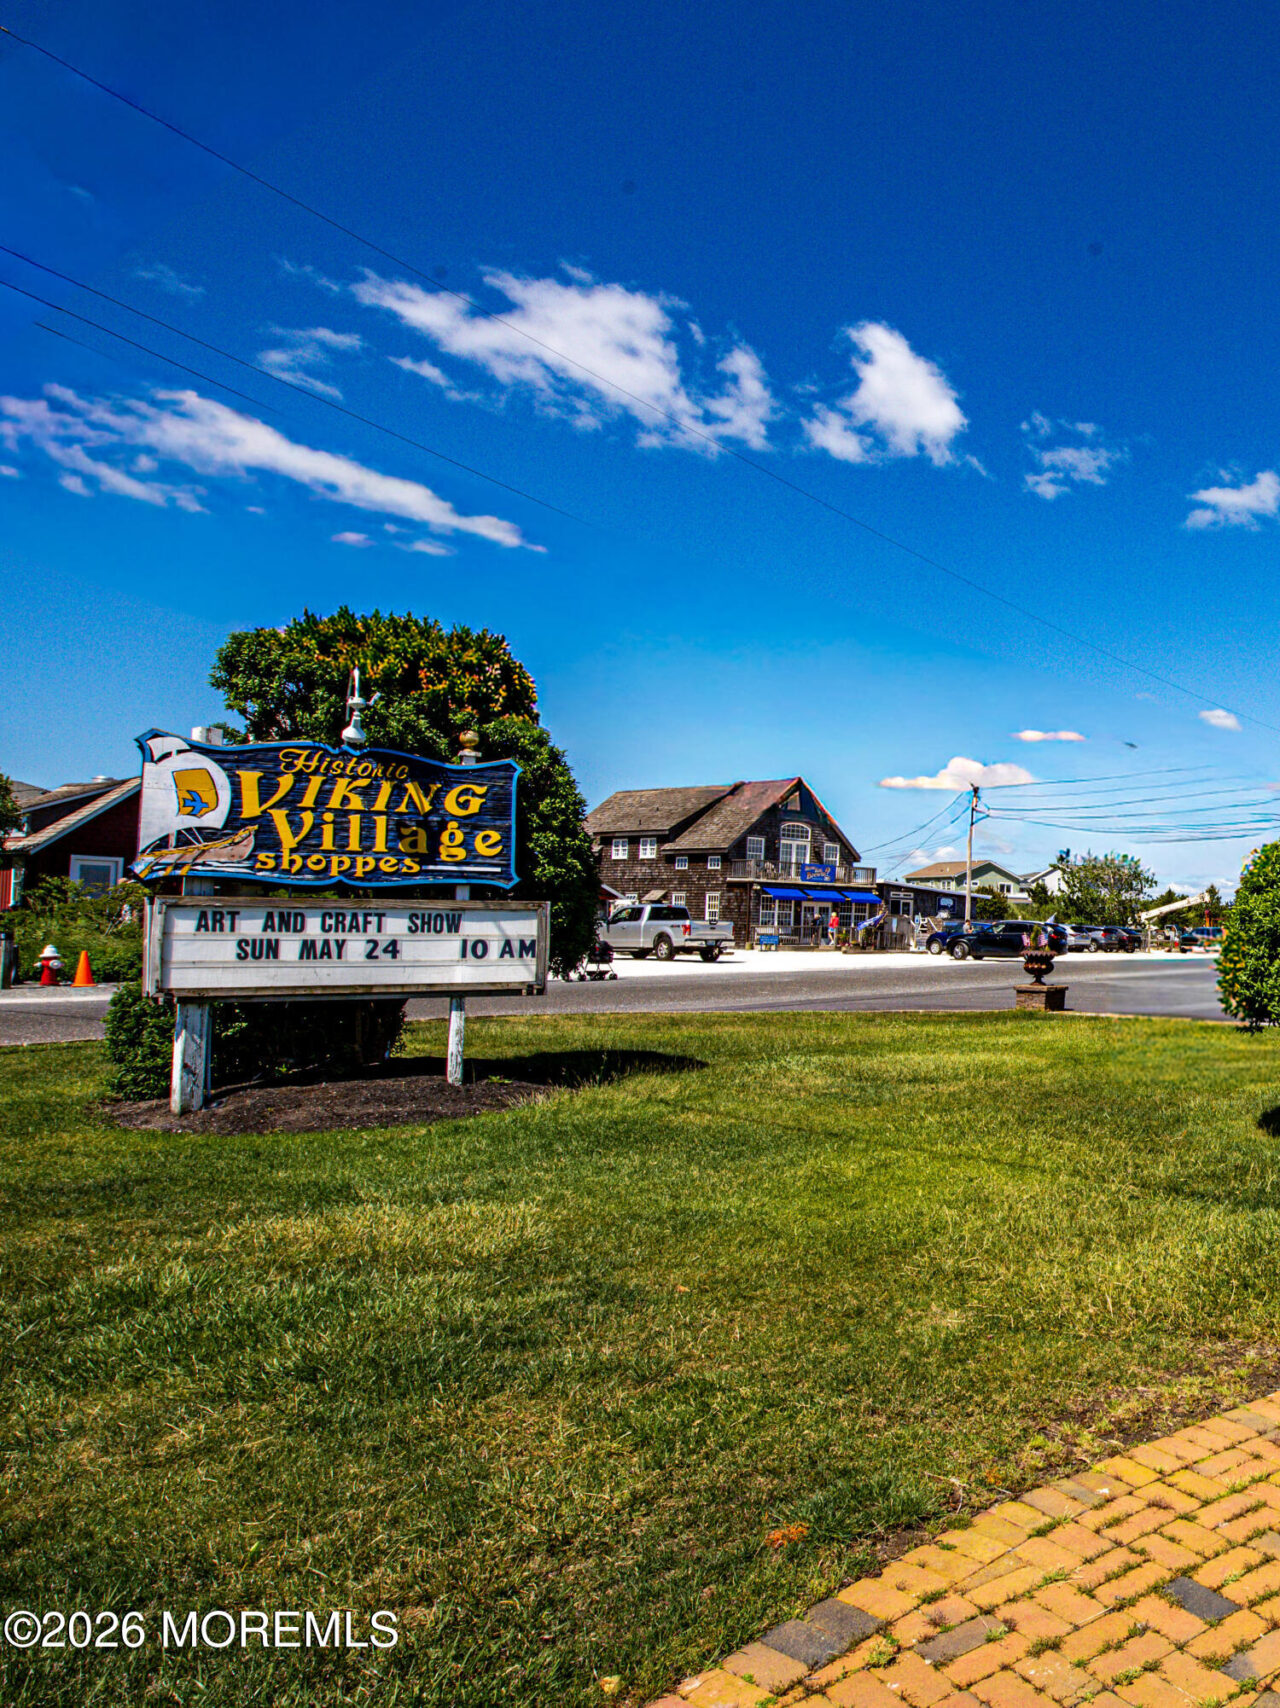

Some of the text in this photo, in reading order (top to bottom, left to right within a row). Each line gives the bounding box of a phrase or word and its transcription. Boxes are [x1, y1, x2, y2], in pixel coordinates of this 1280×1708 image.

[279, 748, 409, 779] Historic
[235, 770, 488, 819] VIKING
[268, 809, 503, 862] Village
[255, 848, 422, 877] shoppes
[195, 911, 463, 934] ART AND CRAFT SHOW
[236, 939, 537, 960] SUN MAY 24 10 AM
